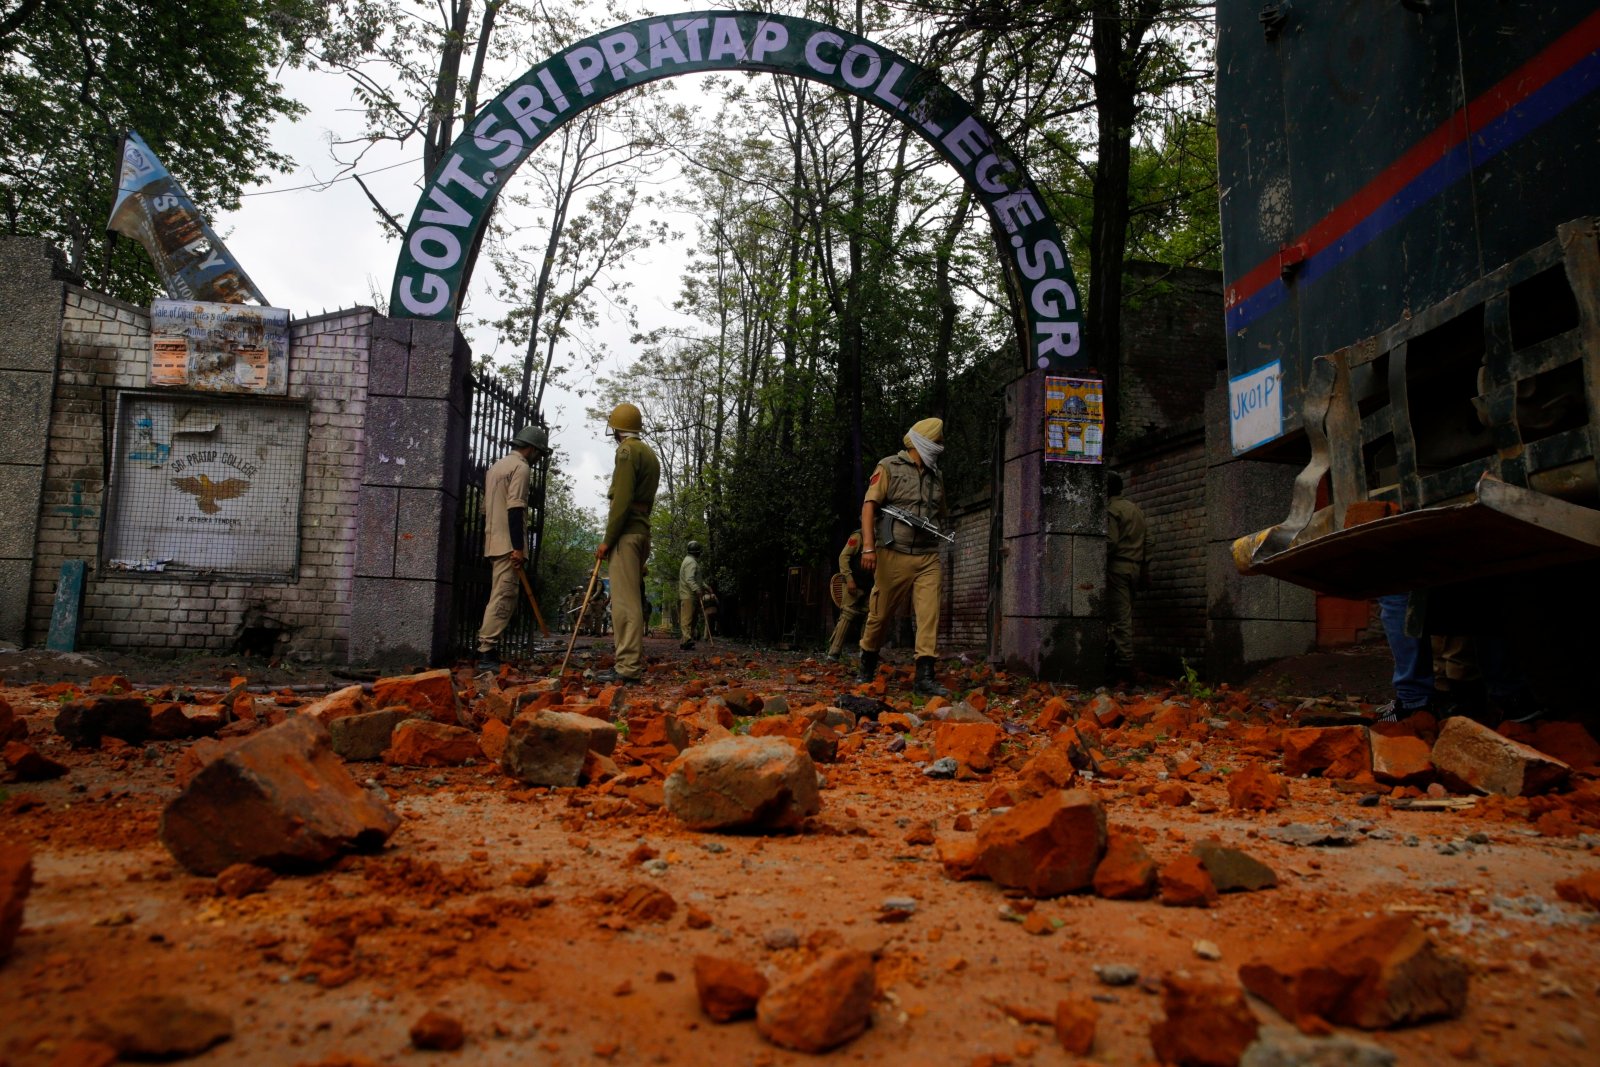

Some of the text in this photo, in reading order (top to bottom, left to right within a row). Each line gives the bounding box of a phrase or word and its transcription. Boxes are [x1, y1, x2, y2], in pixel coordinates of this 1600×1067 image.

[400, 153, 498, 316] GOVT.
[474, 68, 570, 167] SRI
[564, 17, 789, 98] PRATAP
[155, 305, 168, 318] Sale
[170, 306, 176, 319] of
[186, 451, 217, 466] PRATAP
[222, 452, 258, 479] COLLEGE
